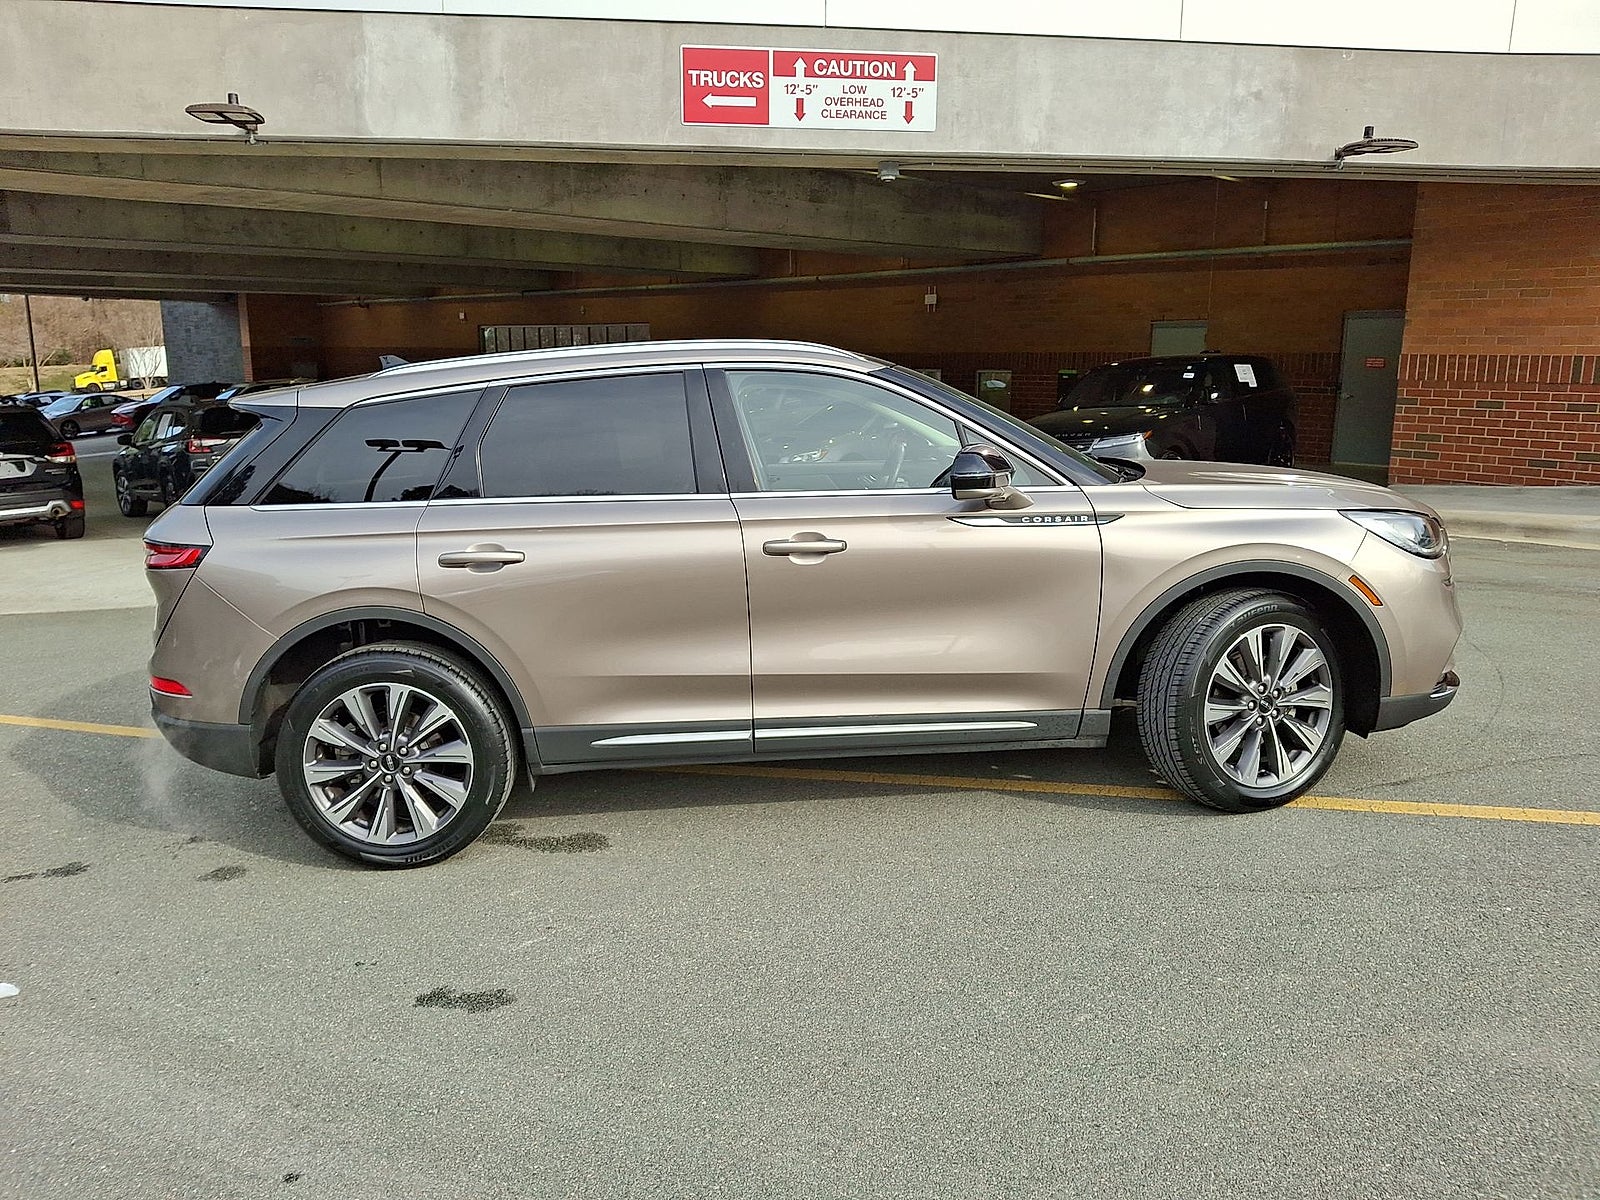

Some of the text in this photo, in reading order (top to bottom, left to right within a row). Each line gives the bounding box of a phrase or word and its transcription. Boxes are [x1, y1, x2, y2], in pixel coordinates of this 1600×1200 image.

[813, 59, 896, 78] CAUTION
[687, 69, 765, 88] TRUCKS
[842, 85, 867, 95] LOW
[824, 97, 885, 108] OVERHEAD
[821, 109, 888, 120] CLEARANCE
[1021, 515, 1089, 523] CORSAIR
